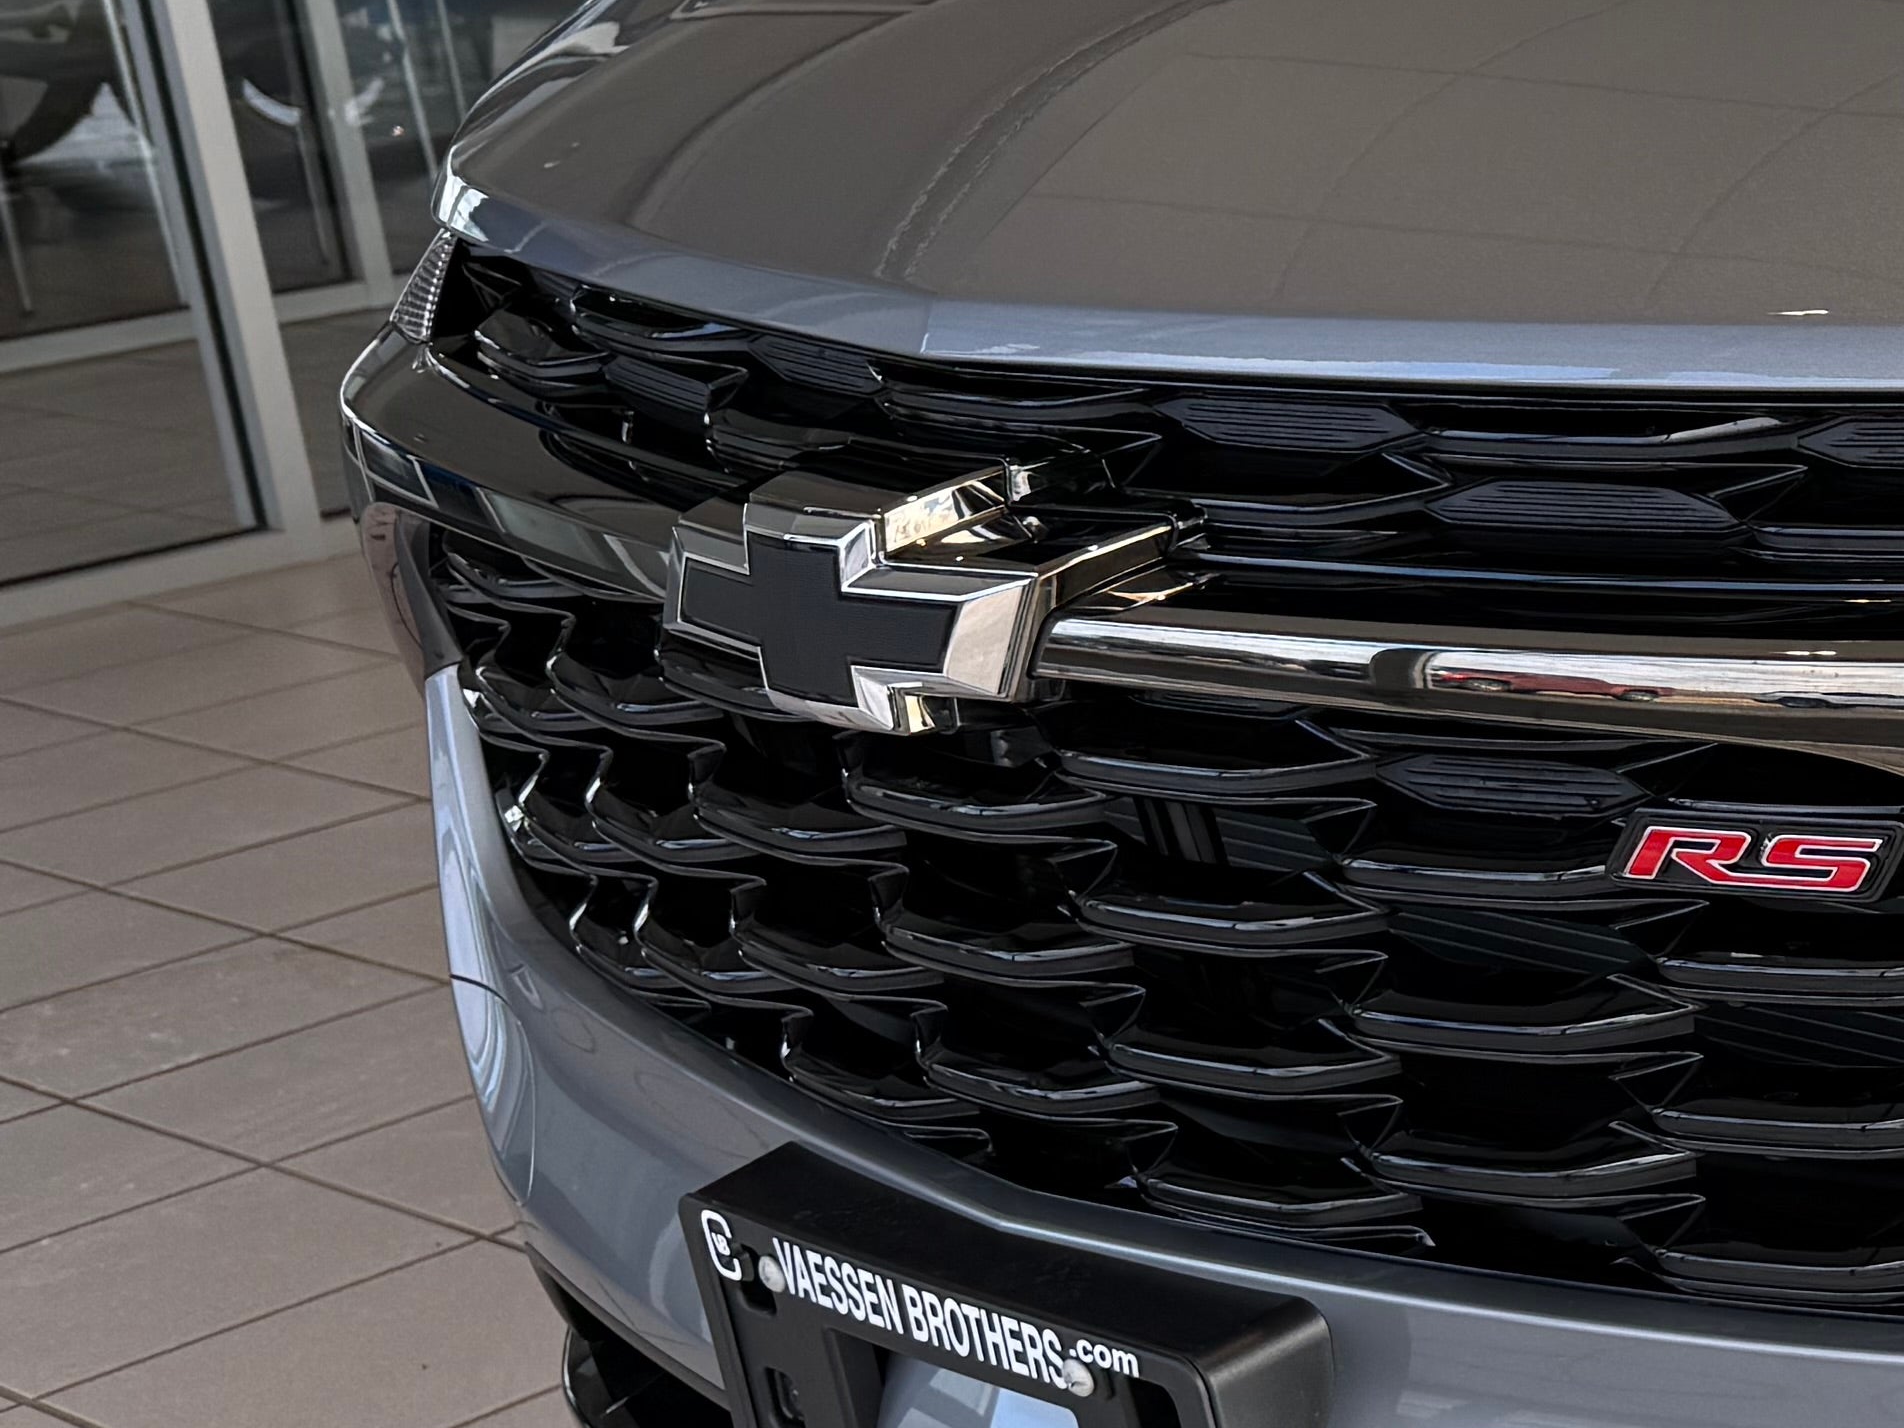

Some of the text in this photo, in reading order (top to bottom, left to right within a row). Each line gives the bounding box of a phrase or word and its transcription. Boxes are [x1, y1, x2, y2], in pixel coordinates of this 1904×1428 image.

[1624, 825, 1884, 893] RS
[772, 1237, 1140, 1390] VAESSEN BROTHERS .com
